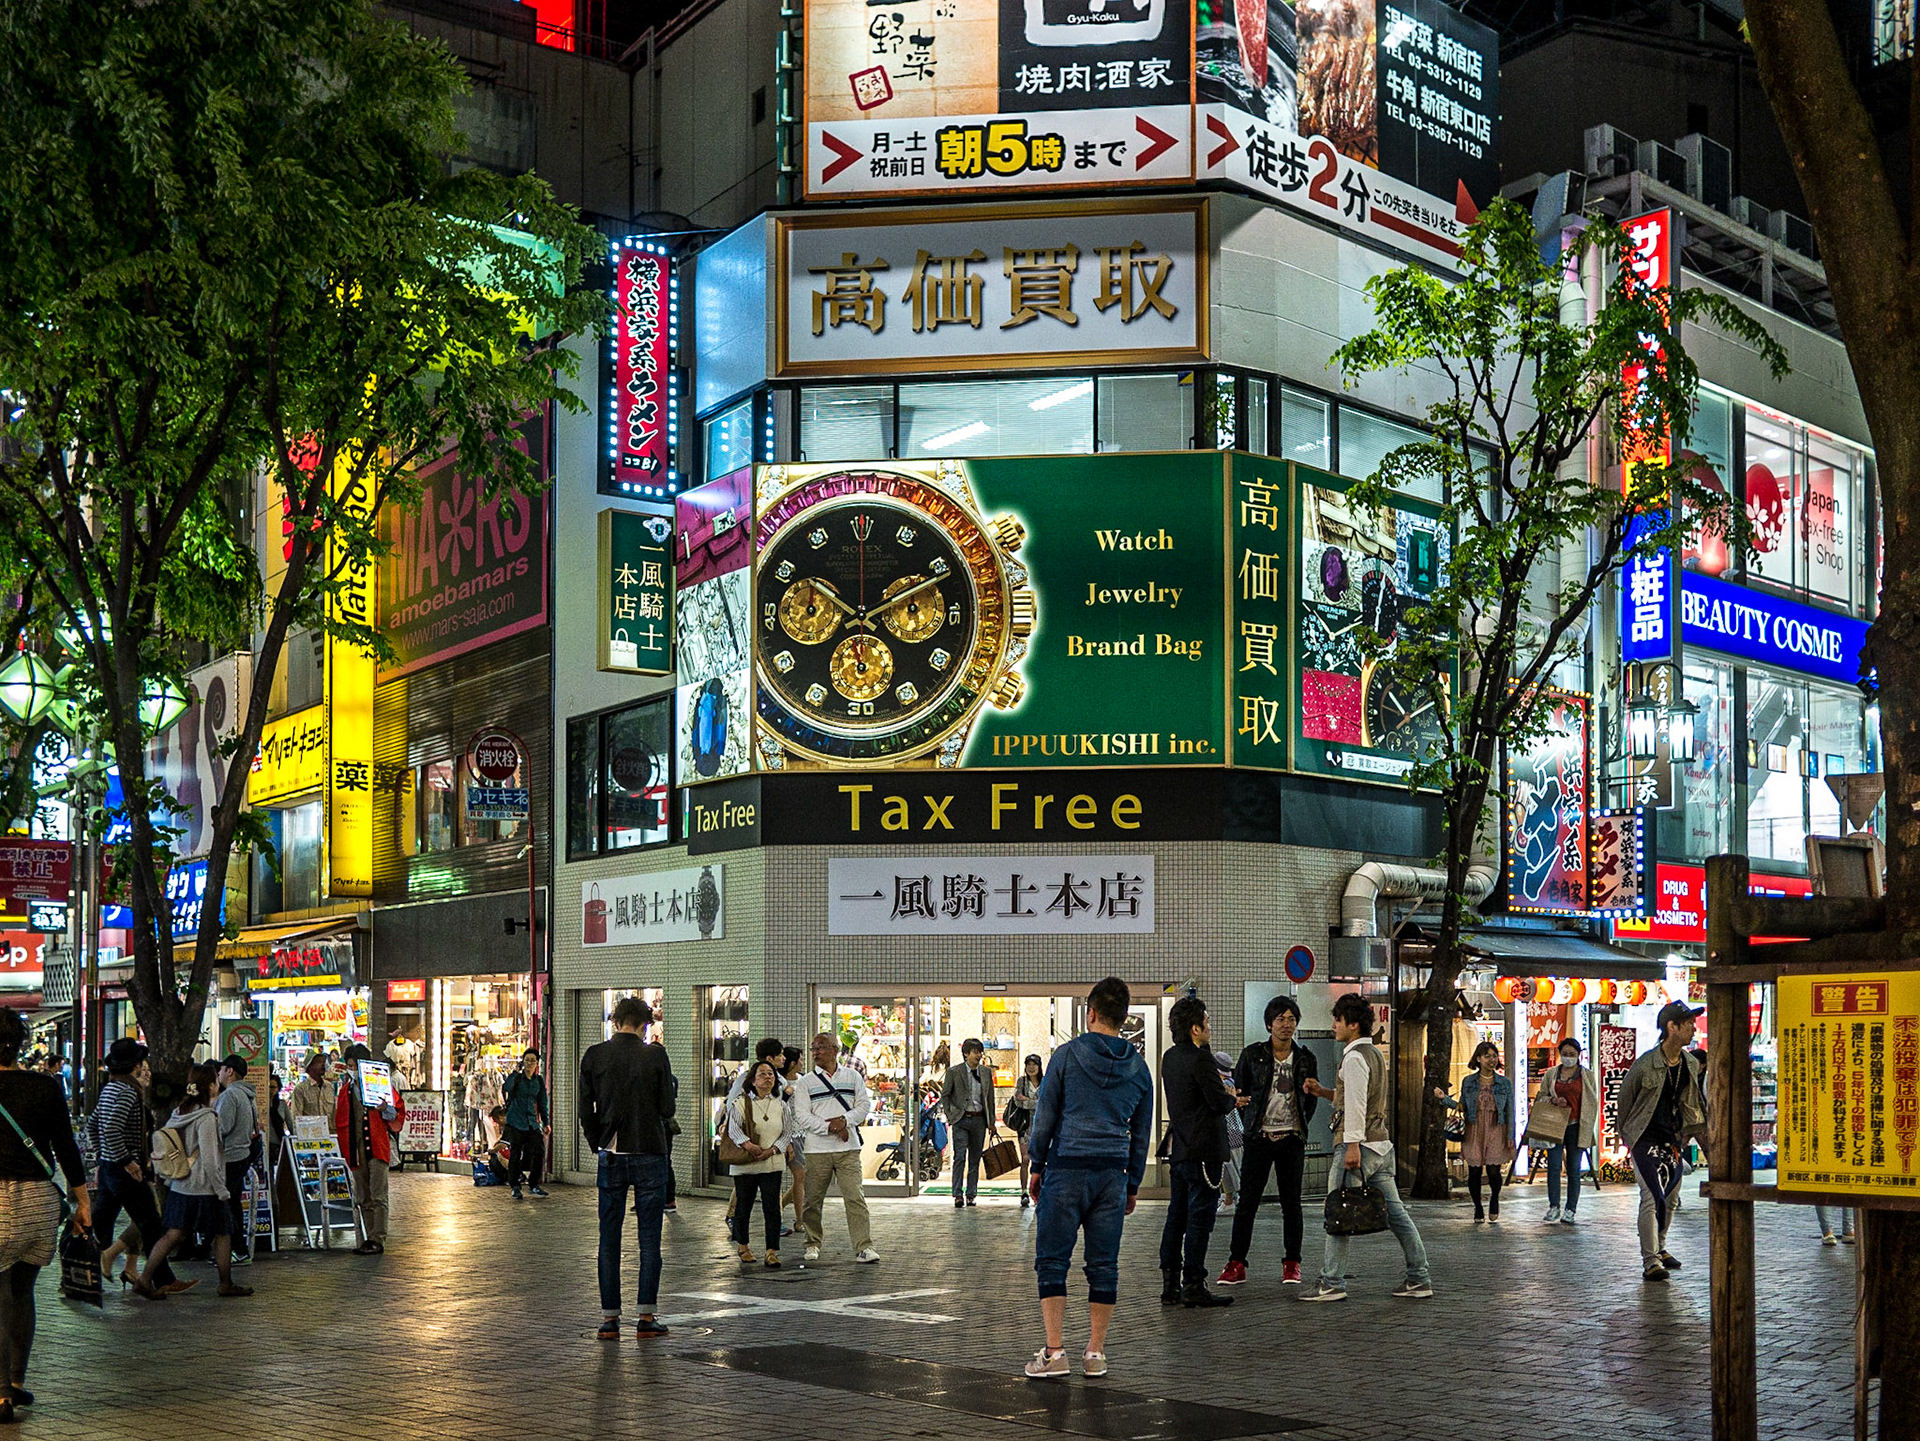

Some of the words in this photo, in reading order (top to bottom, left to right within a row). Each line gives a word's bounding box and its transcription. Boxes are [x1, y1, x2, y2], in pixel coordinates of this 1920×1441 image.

[1066, 12, 1121, 25] Gyu-Kaku
[1436, 33, 1483, 82] 新宿店
[1014, 57, 1175, 95] 焼肉酒家
[1408, 52, 1482, 101] 03-5312-1129
[1386, 69, 1418, 109] 牛角
[1420, 85, 1491, 145] 新宿東口店
[1384, 101, 1406, 123] TEL
[1409, 113, 1483, 159] 03-5367-1129
[936, 120, 1066, 180] 朝5時
[1074, 139, 1127, 168] まで
[869, 156, 926, 178] 祝前日
[1245, 125, 1371, 223] 徒歩2分
[1372, 187, 1458, 238] この先突き当りを左
[806, 239, 1178, 336] 高価買取
[625, 256, 661, 450] 横浜家系ラーメン
[1094, 529, 1175, 552] Watch
[1806, 518, 1843, 546] ax-free
[841, 545, 883, 553] ROEX
[1816, 542, 1844, 574] Shop
[390, 556, 529, 630] amoebamars
[614, 562, 639, 621] 本店
[639, 545, 665, 651] 一風騎士
[1084, 582, 1183, 609] Jewelry
[401, 591, 515, 650] www.mars-saja.com
[764, 602, 777, 632] 45
[948, 601, 962, 627] 15
[1238, 475, 1282, 747] 高価買取
[1681, 588, 1771, 645] BEAUTY
[1773, 616, 1843, 664] COSME
[1066, 635, 1146, 657] Brand
[1153, 635, 1204, 661] Bag
[847, 702, 875, 716] 30
[479, 749, 515, 767] 消火栓
[992, 733, 1160, 757] IPPUUKISHI
[1168, 733, 1217, 756] inc.
[335, 760, 369, 792] 薬
[483, 789, 529, 805] セキネ
[838, 784, 954, 831] Tax
[991, 782, 1143, 831] Free
[694, 804, 720, 834] Tax
[722, 800, 756, 828] Free
[12, 860, 54, 879] 禁止
[838, 871, 1144, 921] 一風騎士本店
[1662, 880, 1689, 896] DRUG
[1672, 896, 1680, 911] &
[597, 886, 702, 930] 一風騎士本店
[1820, 985, 1880, 1013] 警告
[405, 1110, 440, 1122] SPECIAL
[409, 1122, 435, 1135] PRICE
